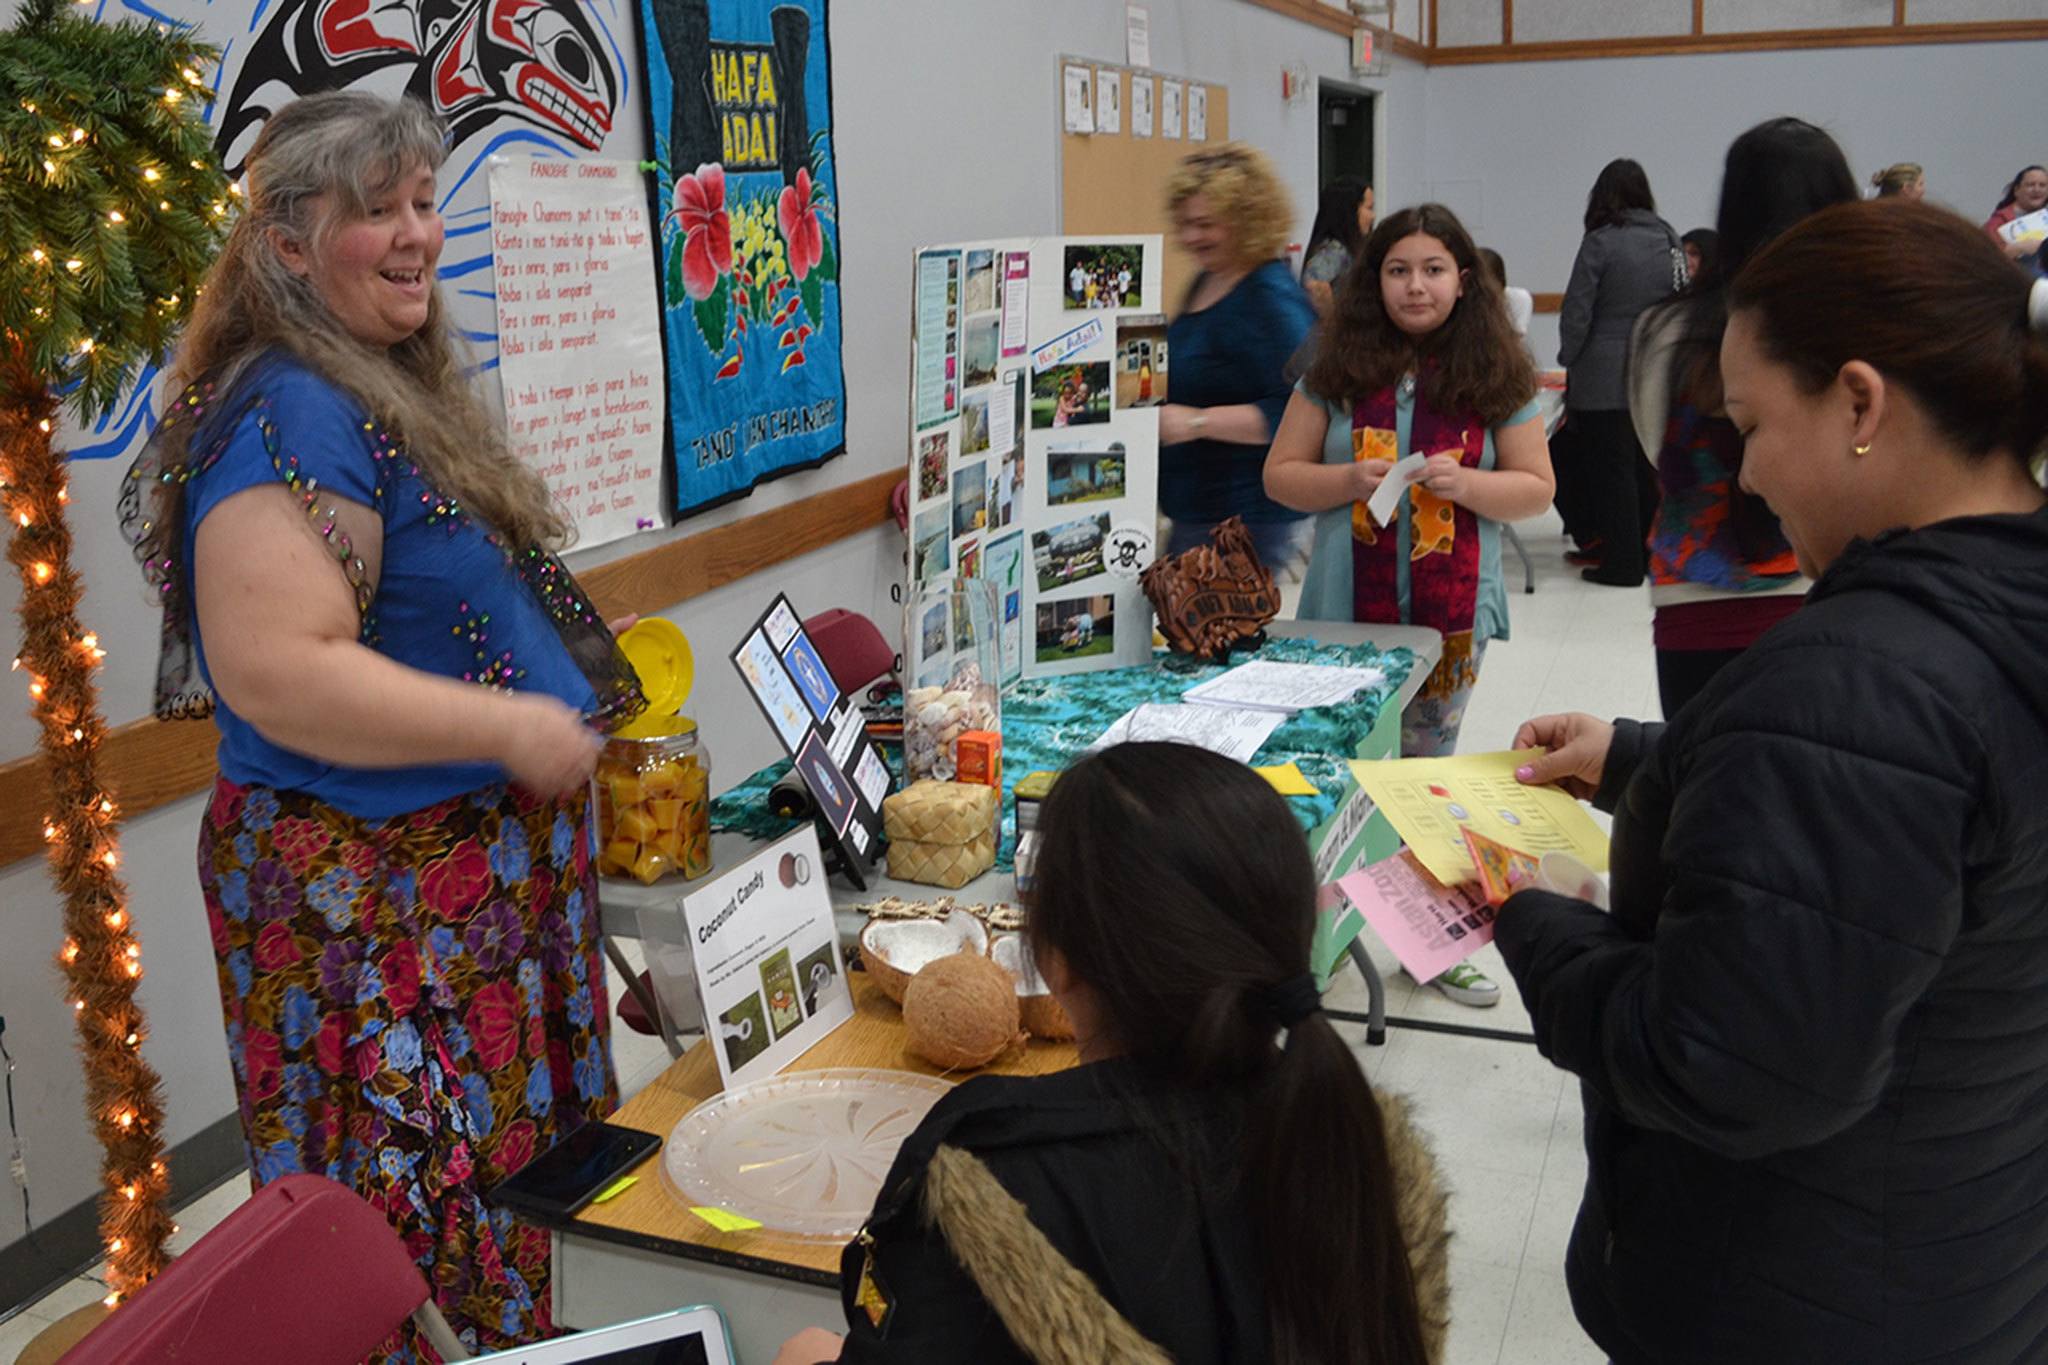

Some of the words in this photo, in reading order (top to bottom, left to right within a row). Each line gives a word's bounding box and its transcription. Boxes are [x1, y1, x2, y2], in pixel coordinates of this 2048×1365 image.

[711, 50, 778, 107] HAFA
[721, 112, 777, 165] ADAI
[579, 208, 592, 225] put
[497, 255, 515, 276] Para
[554, 262, 570, 277] para
[585, 254, 609, 276] gloria
[500, 308, 518, 328] Para
[560, 312, 577, 328] para
[593, 303, 616, 324] gloria
[606, 379, 624, 395] para
[609, 443, 634, 463] Guam
[699, 898, 736, 943] Coconut
[737, 871, 764, 904] Candy
